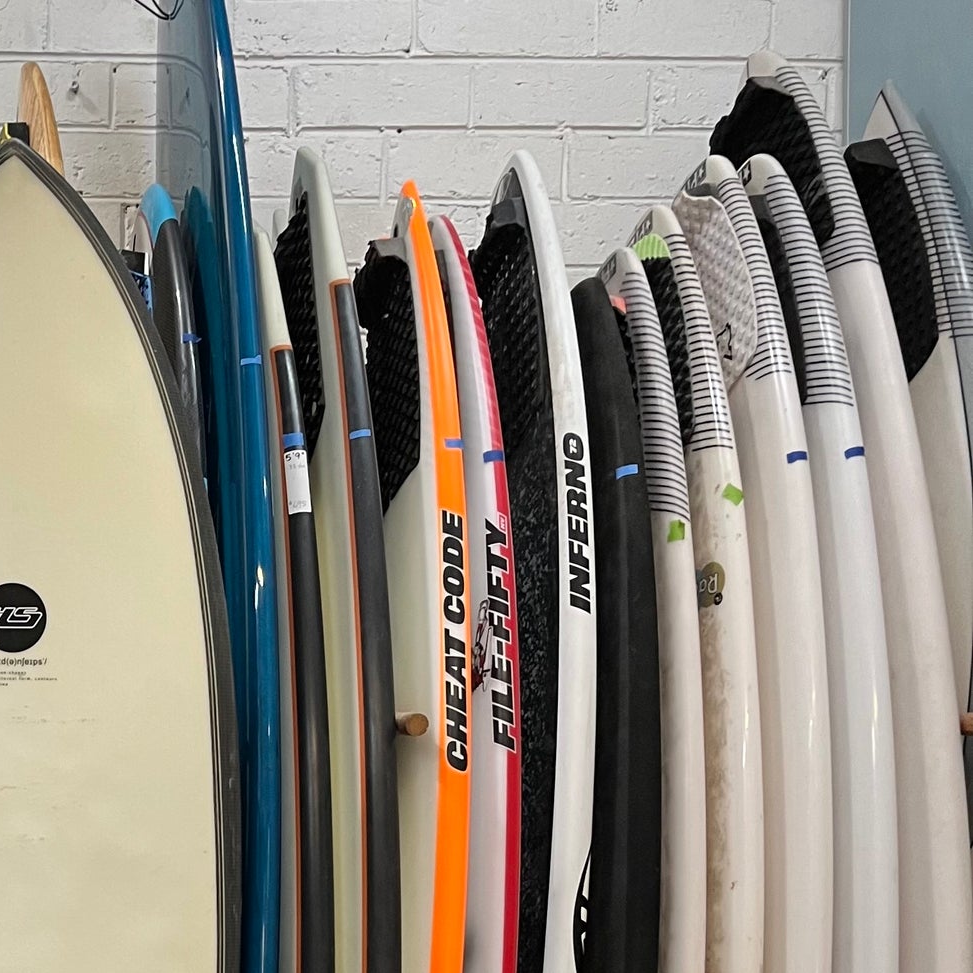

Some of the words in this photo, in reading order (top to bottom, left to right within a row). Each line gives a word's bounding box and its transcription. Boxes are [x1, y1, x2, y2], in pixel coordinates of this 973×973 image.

[442, 510, 465, 625] CODE
[563, 432, 591, 614] INFERNO
[444, 628, 468, 772] CHEAT
[485, 518, 516, 752] FILE-FIFTY
